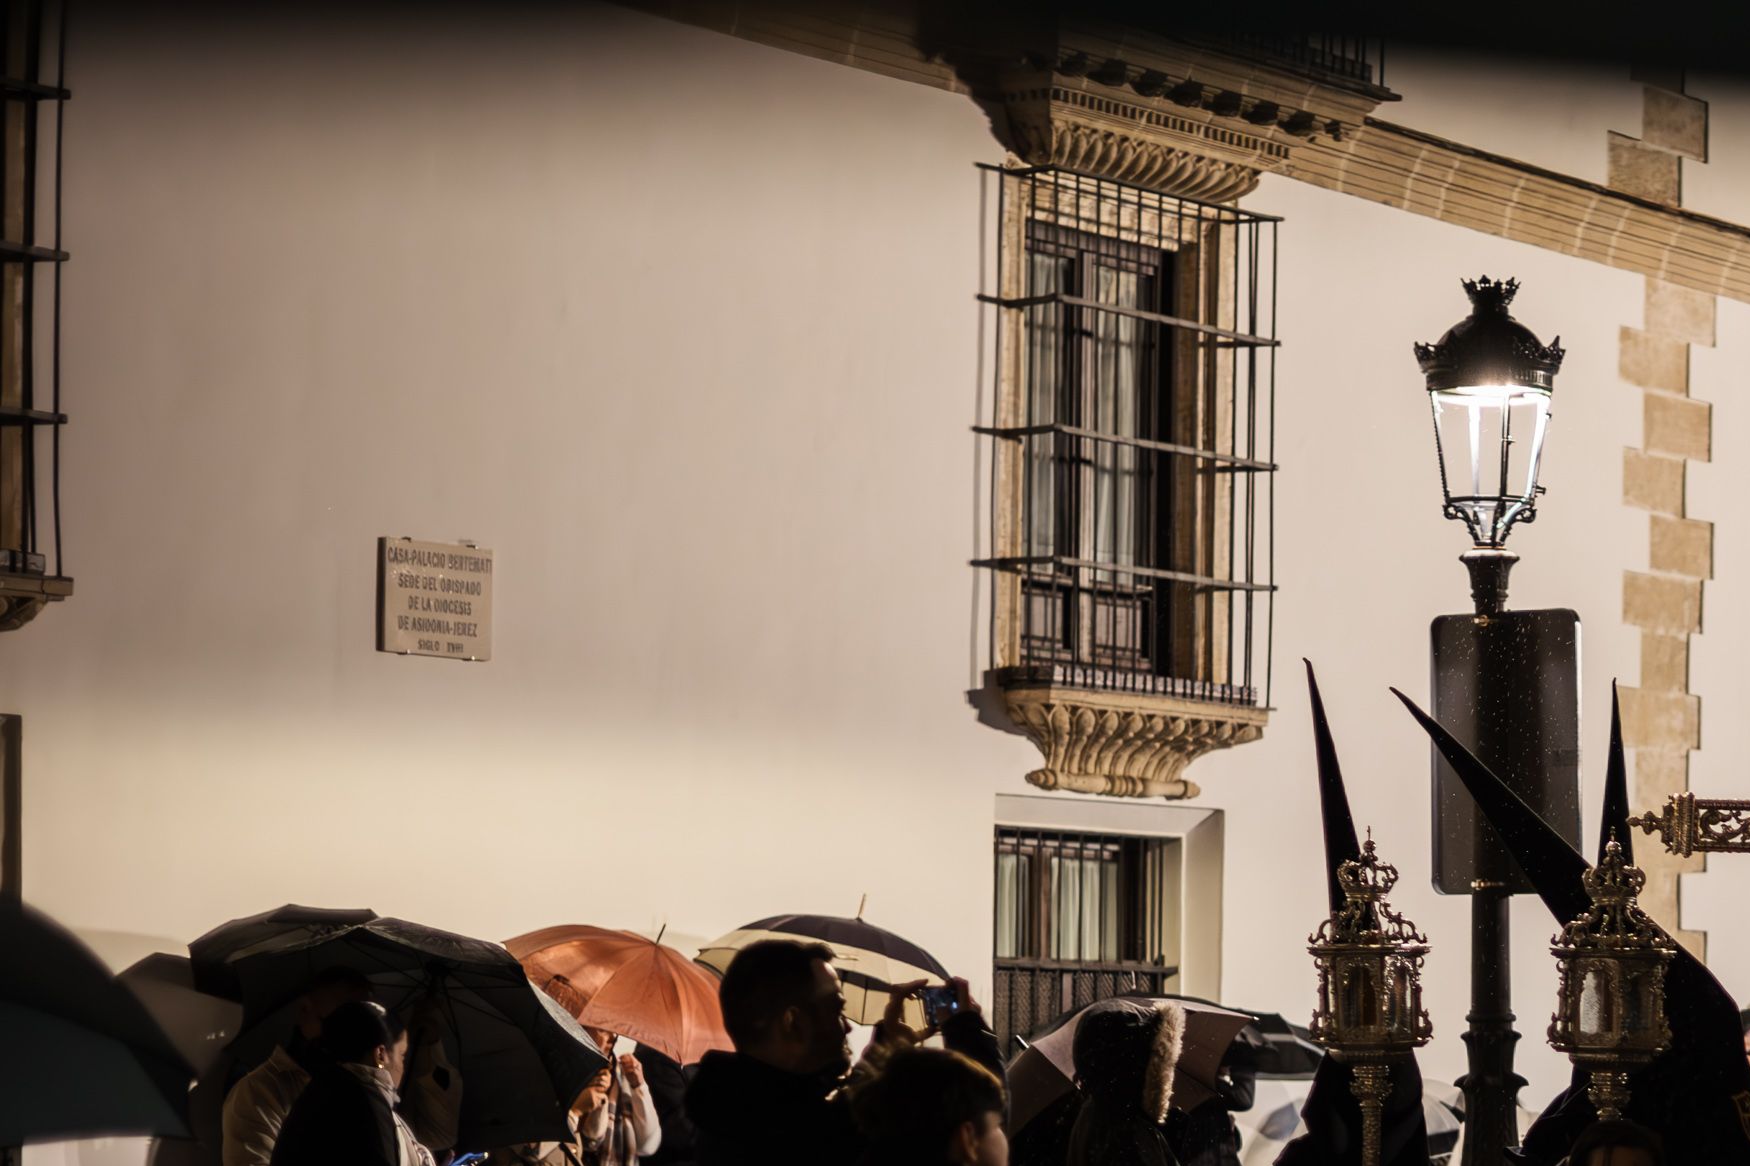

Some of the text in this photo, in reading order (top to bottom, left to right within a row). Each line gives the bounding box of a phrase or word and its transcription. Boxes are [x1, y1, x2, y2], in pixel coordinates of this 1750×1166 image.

[387, 547, 445, 569] CASA-PALACIO
[398, 573, 481, 596] SEDE DEL OBISPADO
[408, 596, 418, 610] DE
[421, 598, 431, 612] LA
[397, 615, 478, 638] DE ASIDONIA-JEREZ
[418, 639, 440, 652] SIGLO
